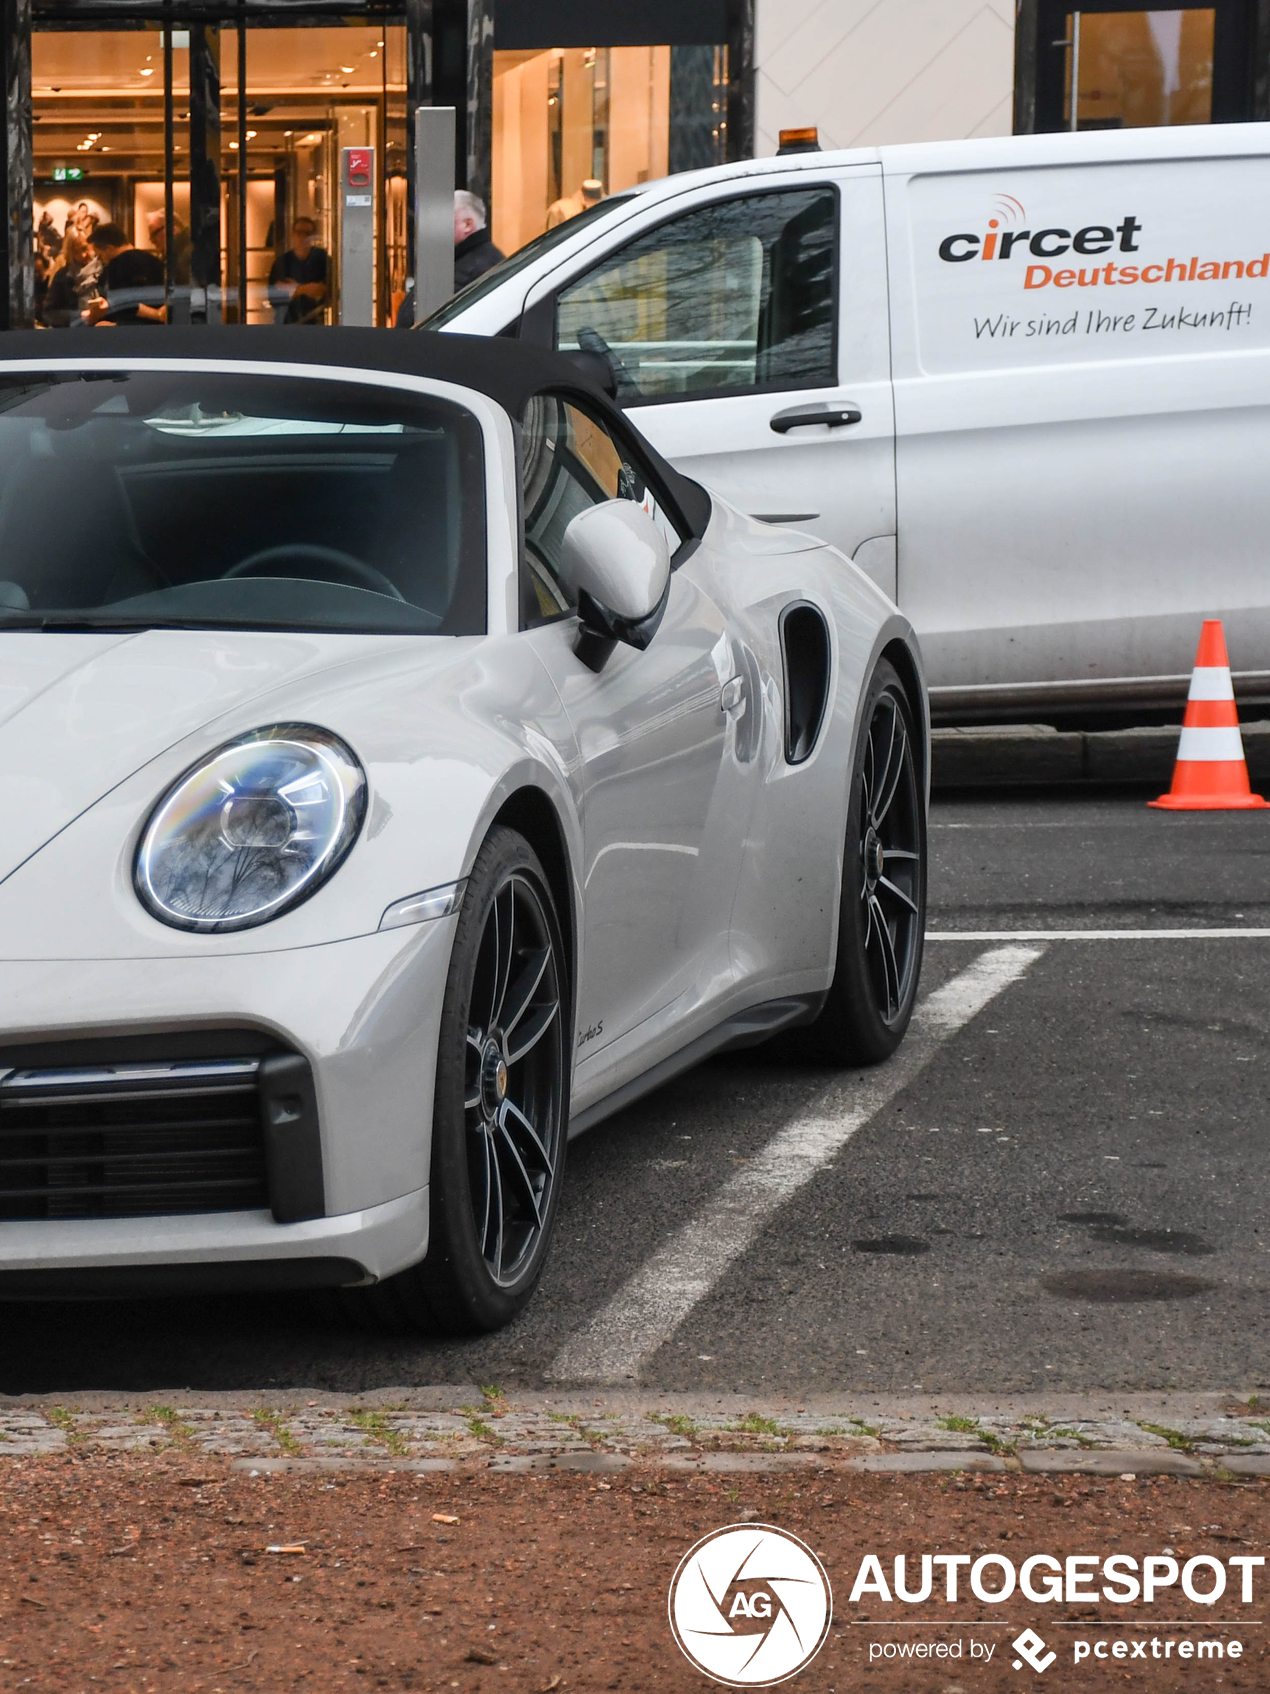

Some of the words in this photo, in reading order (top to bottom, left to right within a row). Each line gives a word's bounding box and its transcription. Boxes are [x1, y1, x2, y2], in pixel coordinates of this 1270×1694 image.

[938, 216, 1142, 262] circet
[1024, 253, 1270, 289] Deutschland
[973, 314, 1021, 339] Wir
[1025, 311, 1079, 337] sind
[1086, 309, 1136, 334] Ihre
[1142, 301, 1253, 331] Zukunft!
